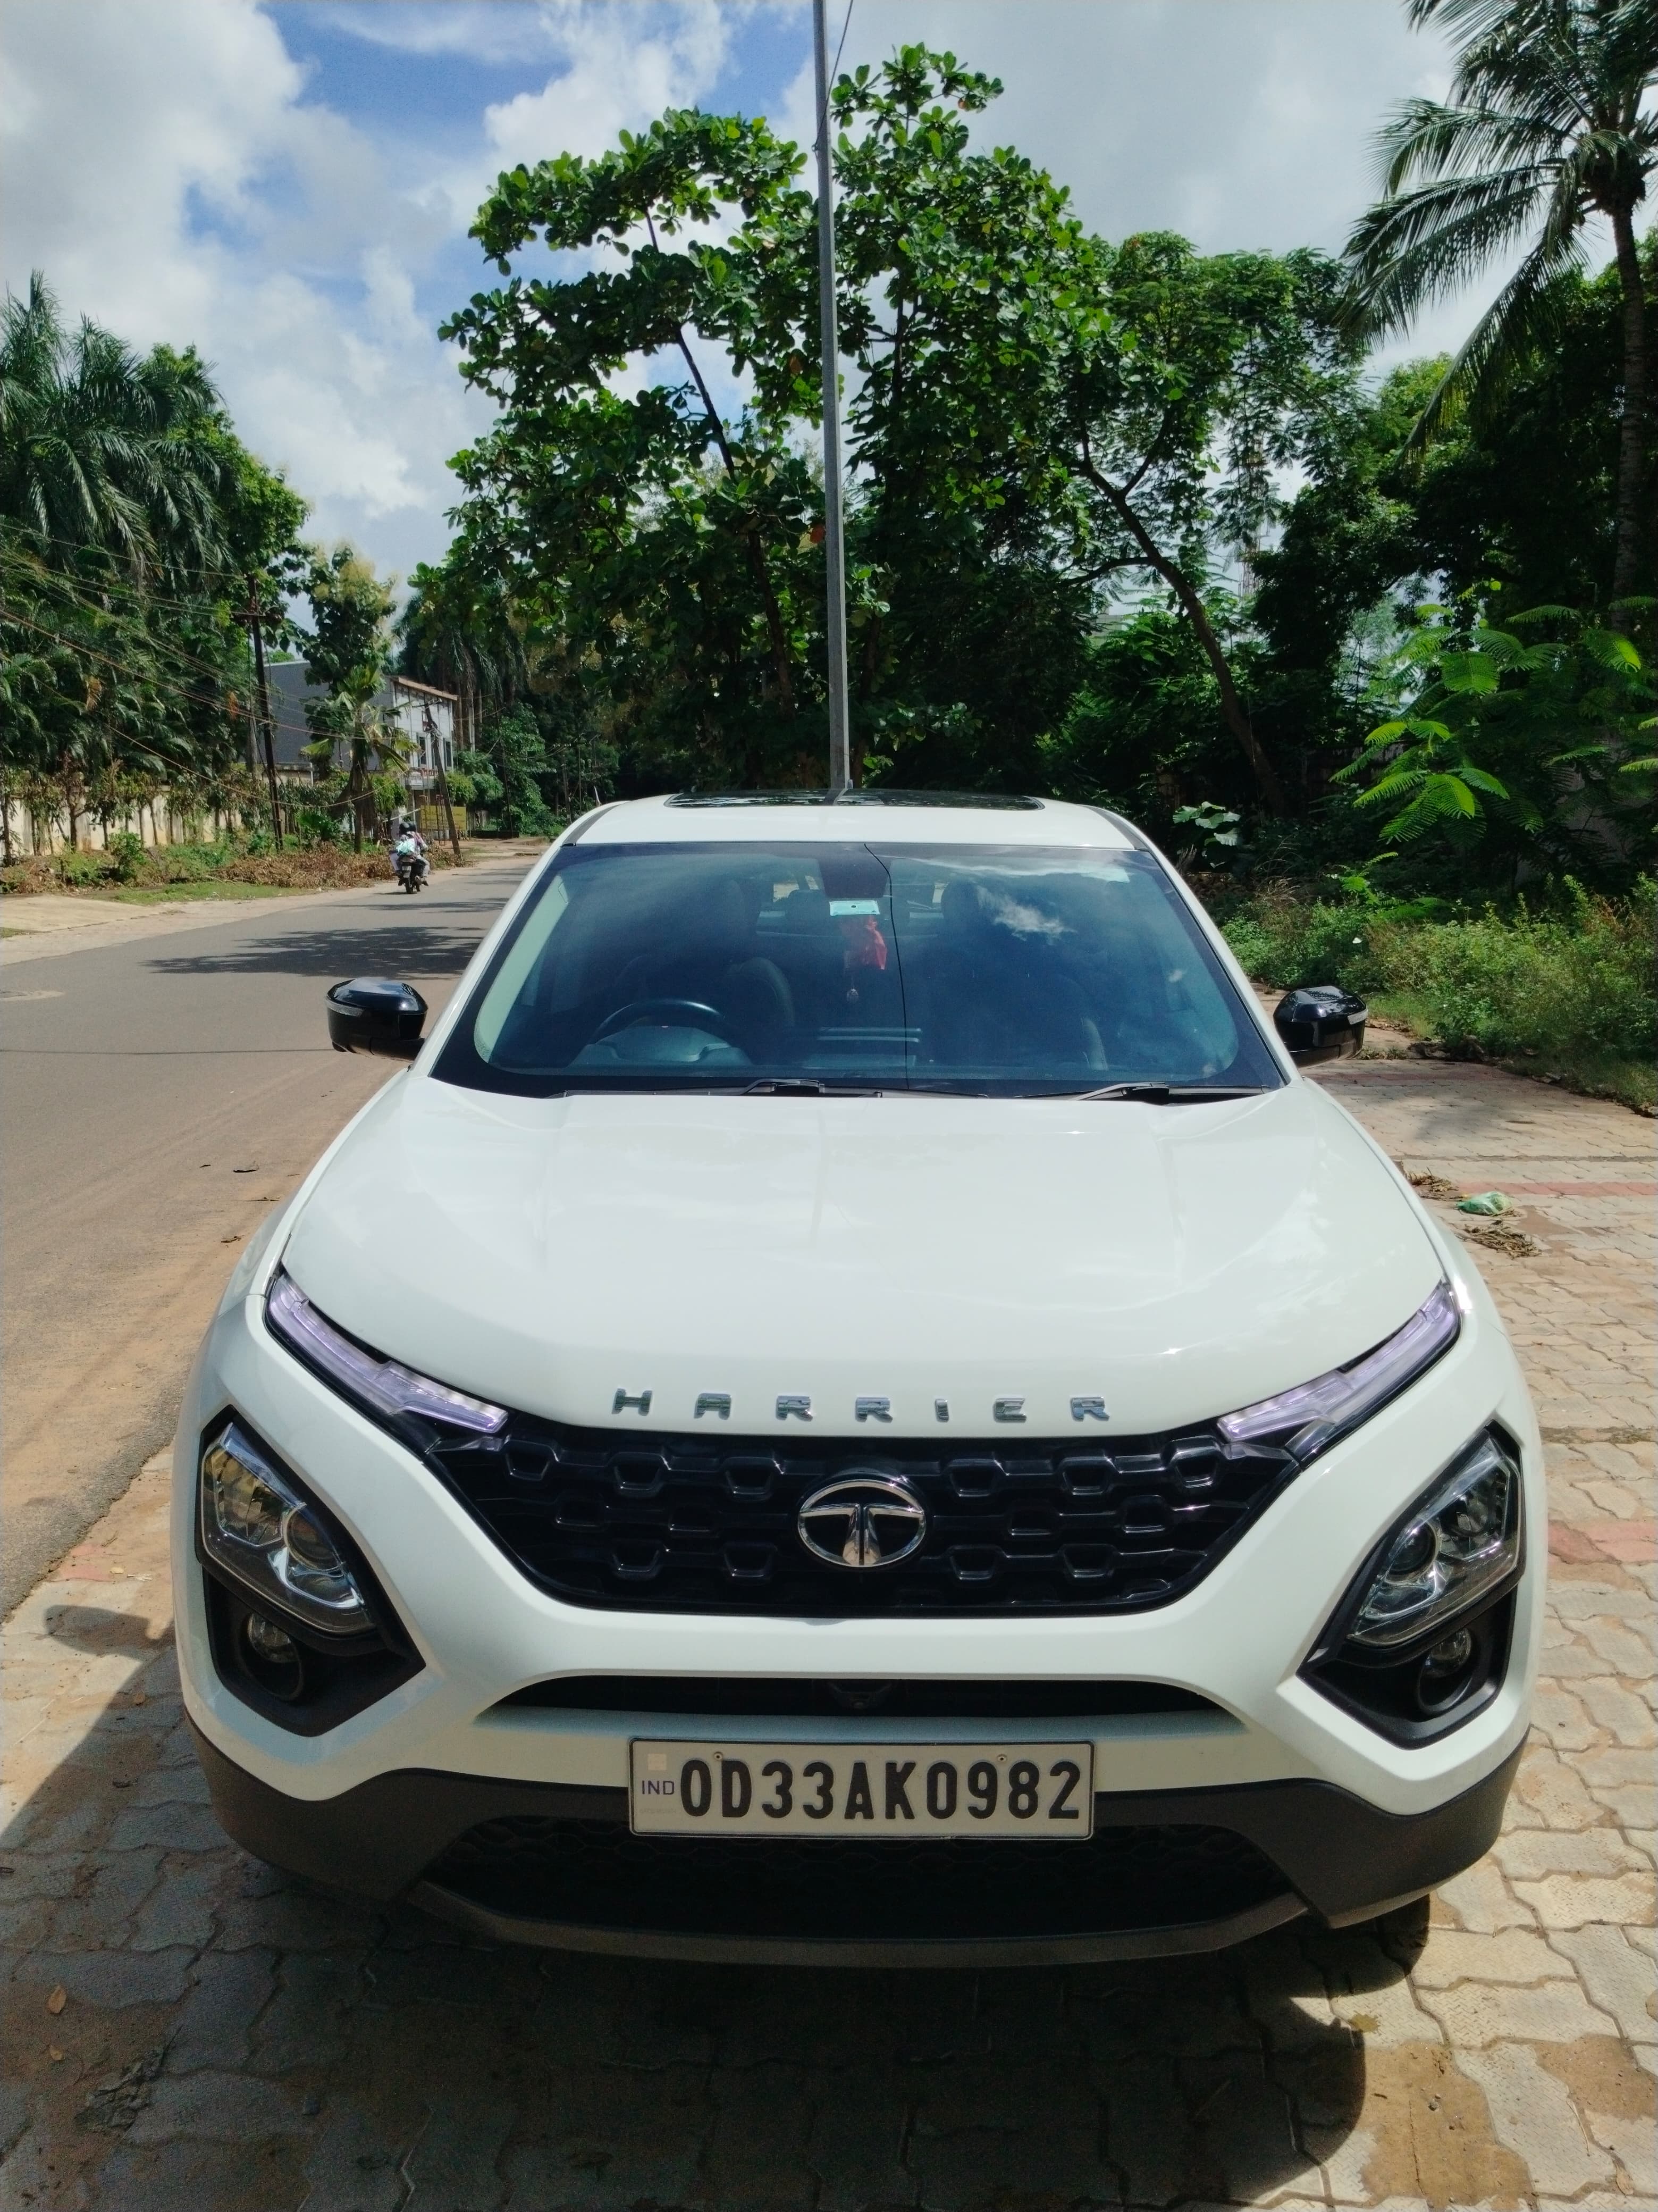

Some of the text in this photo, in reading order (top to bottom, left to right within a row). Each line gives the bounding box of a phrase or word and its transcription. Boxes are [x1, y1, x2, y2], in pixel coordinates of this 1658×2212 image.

[611, 1388, 1111, 1424] HARRIER
[641, 1780, 675, 1795] IND
[680, 1758, 1081, 1820] OD33AK0982
